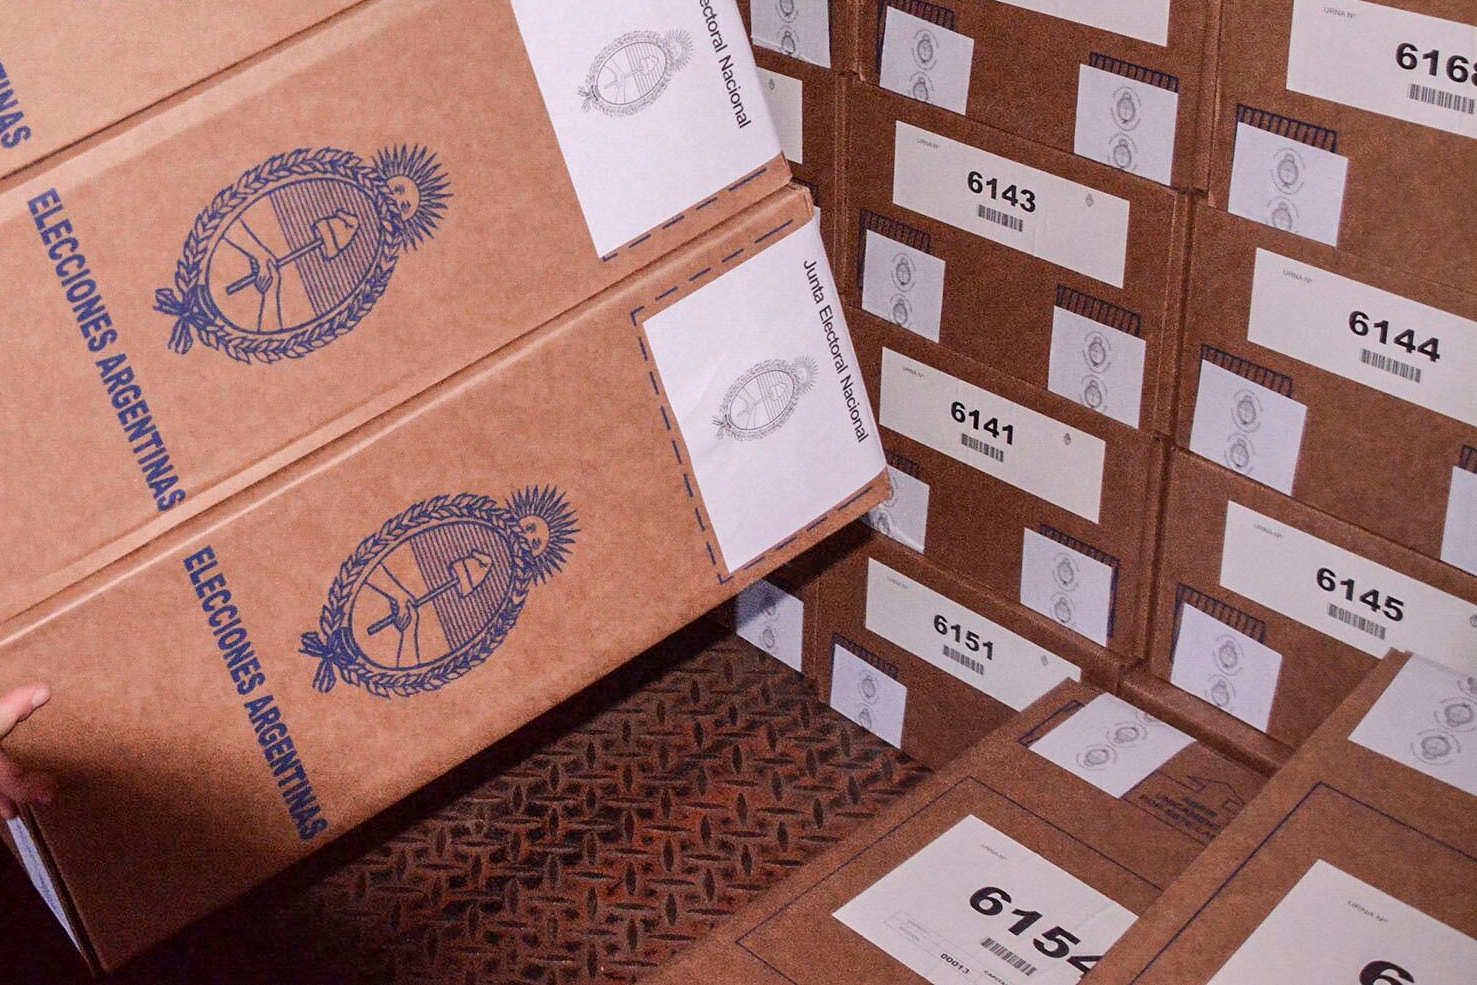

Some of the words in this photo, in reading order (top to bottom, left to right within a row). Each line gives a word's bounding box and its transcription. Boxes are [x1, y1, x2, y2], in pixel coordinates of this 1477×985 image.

[1395, 42, 1477, 87] 616
[718, 55, 752, 130] Nacional
[966, 170, 1037, 214] 6143
[27, 187, 118, 353] ELECCIONES
[94, 352, 186, 513] ARGENTINAS
[803, 259, 825, 304] Junta
[818, 304, 849, 375] Electoral
[839, 374, 869, 444] Nacional
[1348, 310, 1441, 363] 6144
[950, 400, 1014, 446] 6141
[1316, 567, 1404, 622] 6145
[933, 613, 995, 661] 6151
[182, 544, 266, 696] ELECCIONES
[243, 694, 328, 841] ARGENTINAS
